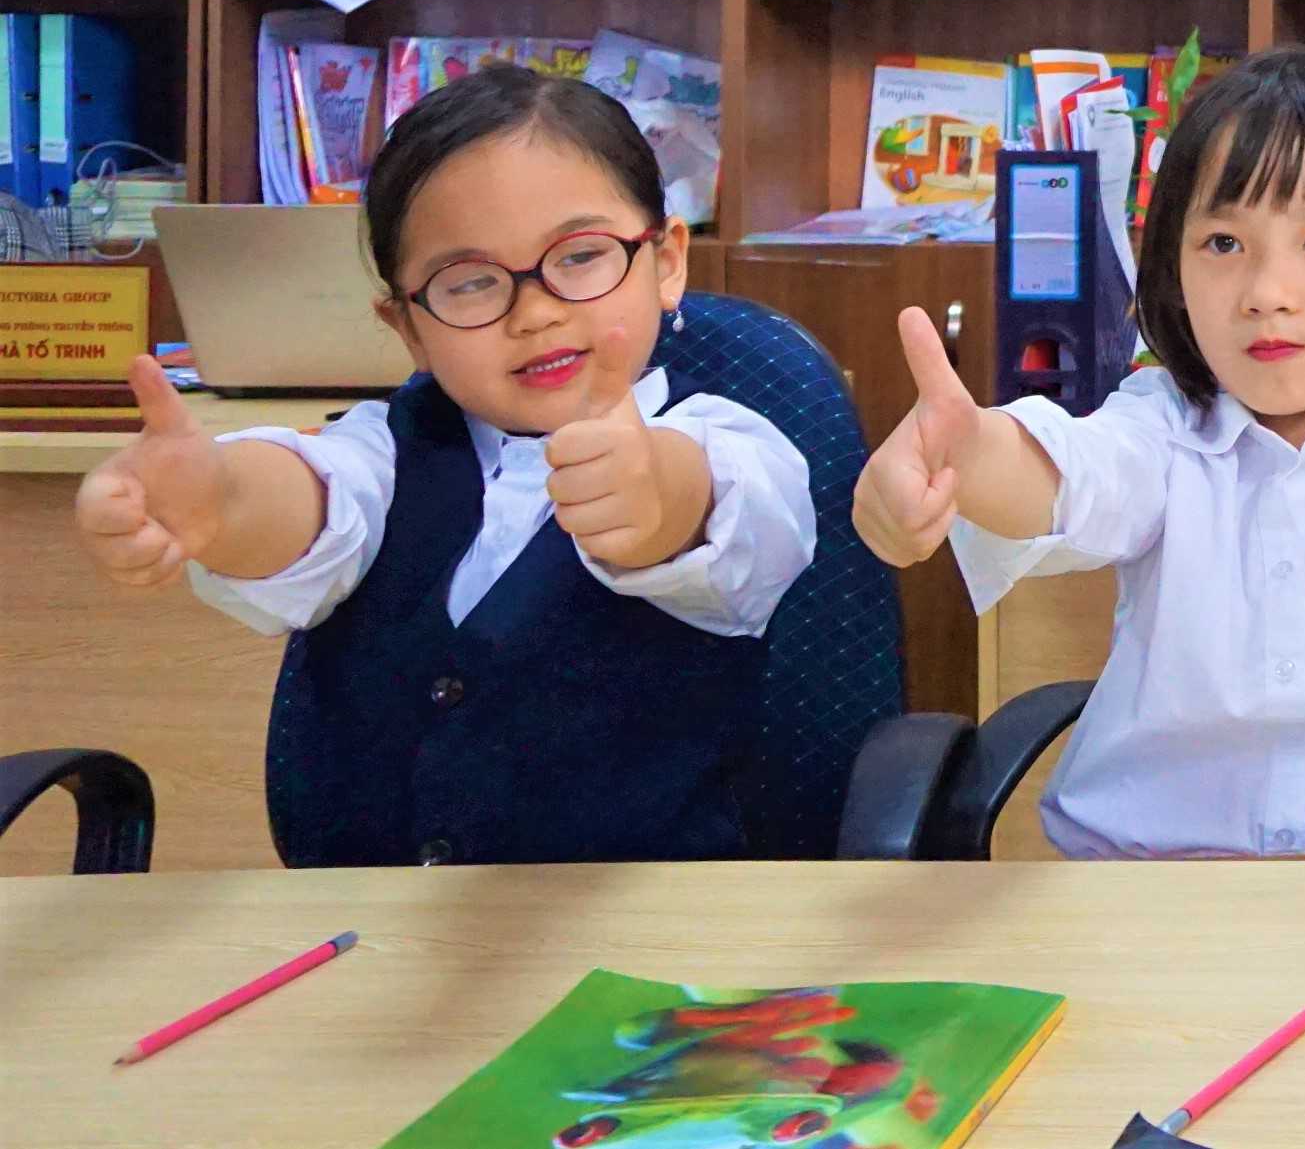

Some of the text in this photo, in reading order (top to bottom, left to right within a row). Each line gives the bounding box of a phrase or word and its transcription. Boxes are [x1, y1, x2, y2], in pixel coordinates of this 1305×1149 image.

[880, 86, 925, 102] English
[63, 291, 112, 303] GROUP
[55, 344, 105, 359] TRINH
